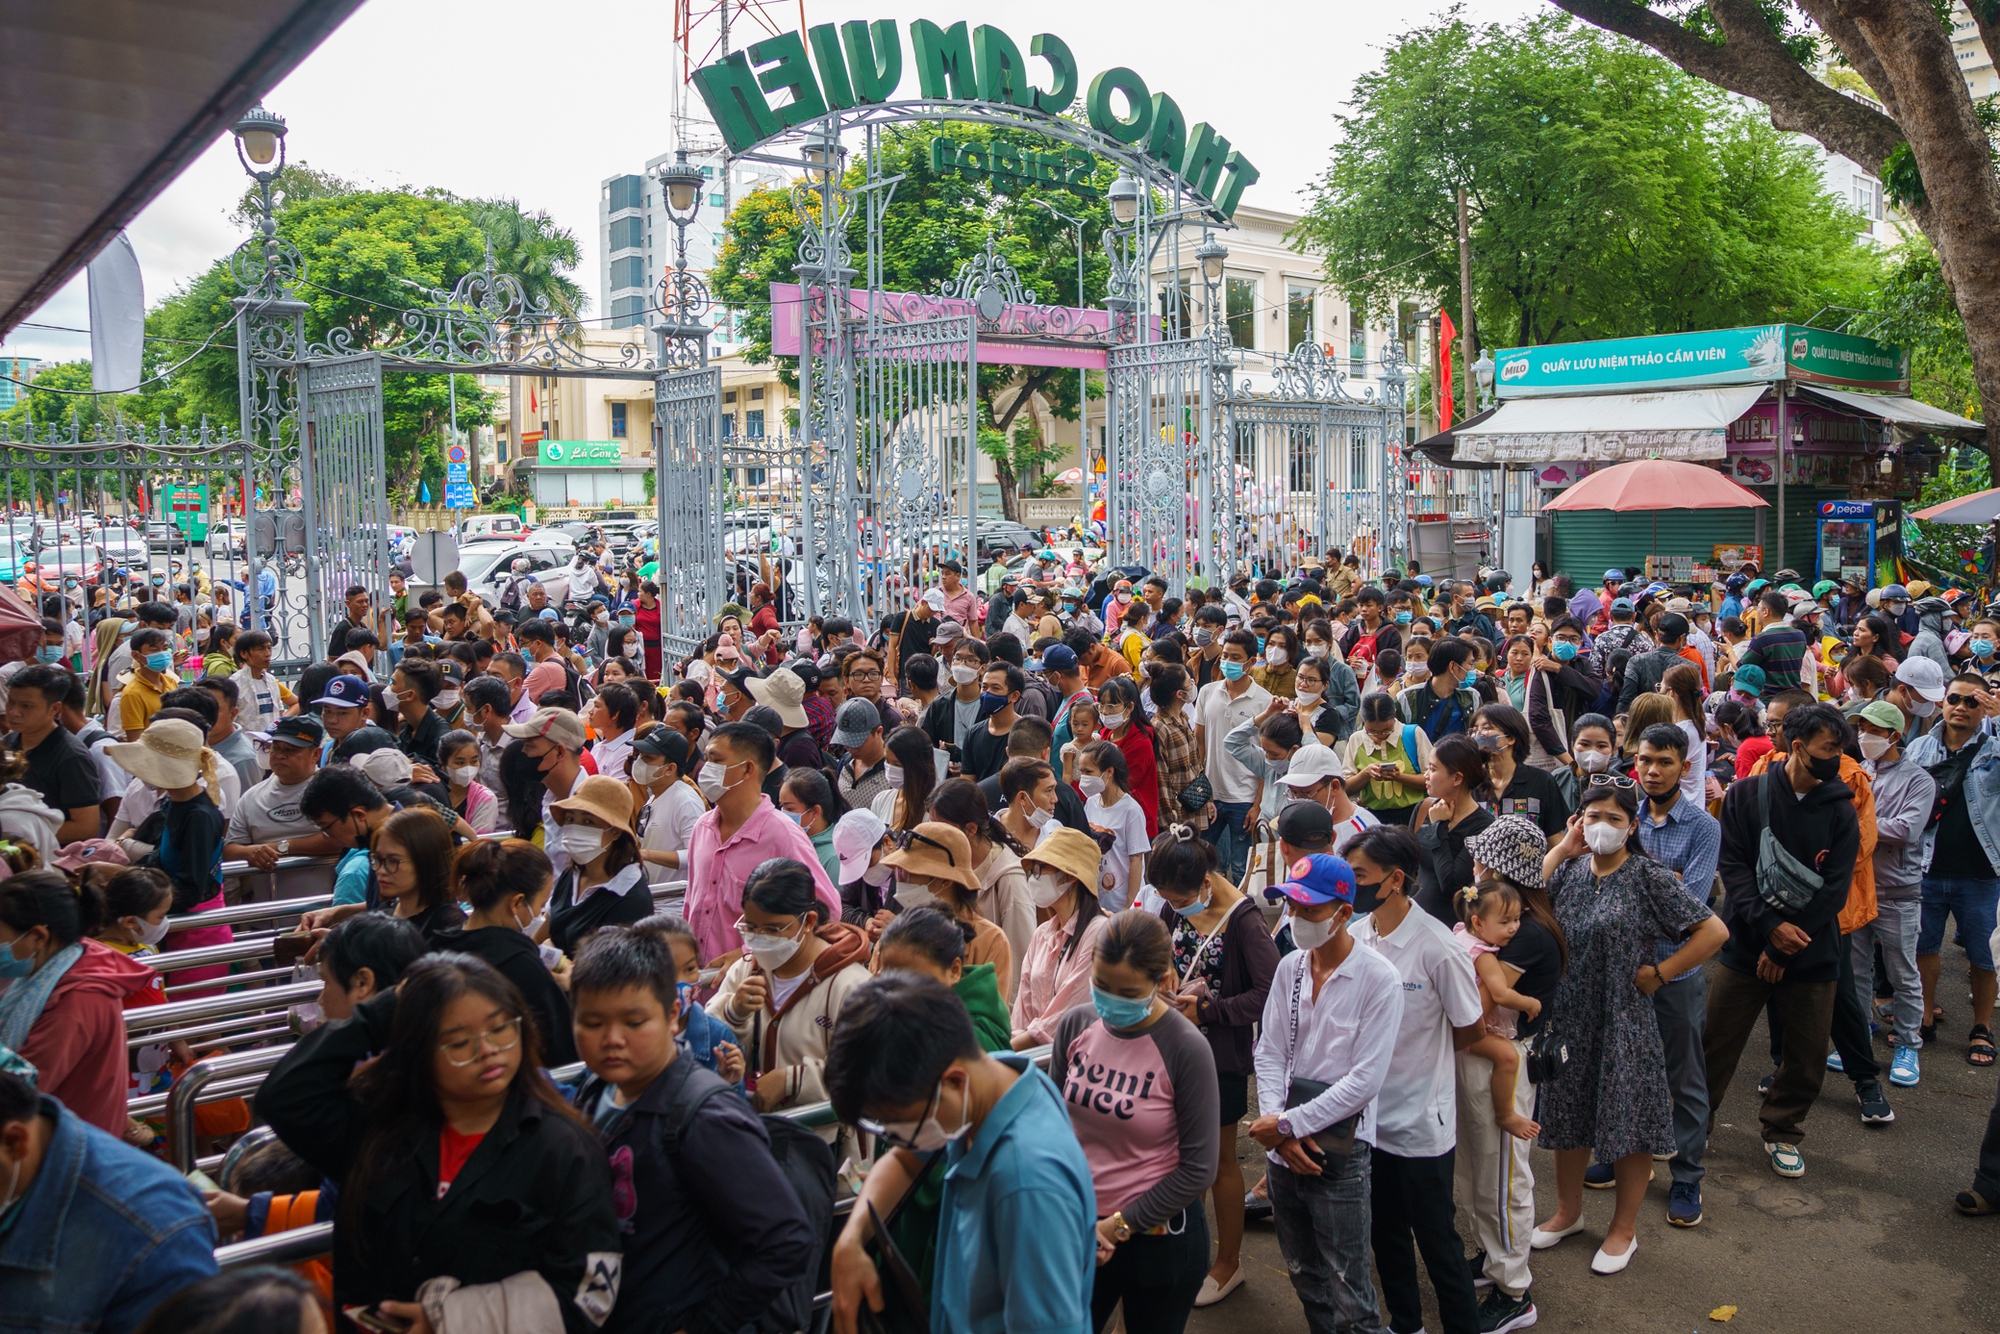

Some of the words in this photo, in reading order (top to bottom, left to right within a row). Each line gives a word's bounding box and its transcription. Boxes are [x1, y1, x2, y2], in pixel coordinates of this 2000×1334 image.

[1573, 357, 1597, 371] LƯU
[1599, 355, 1629, 370] NIỆM
[1630, 350, 1663, 366] THẢO
[1696, 346, 1726, 361] VIÊN
[1793, 344, 1806, 355] MILO
[1504, 364, 1527, 376] MILO
[1734, 413, 1773, 441] VIÊN
[1837, 504, 1865, 515] pepsi
[1068, 1051, 1155, 1100] Semi
